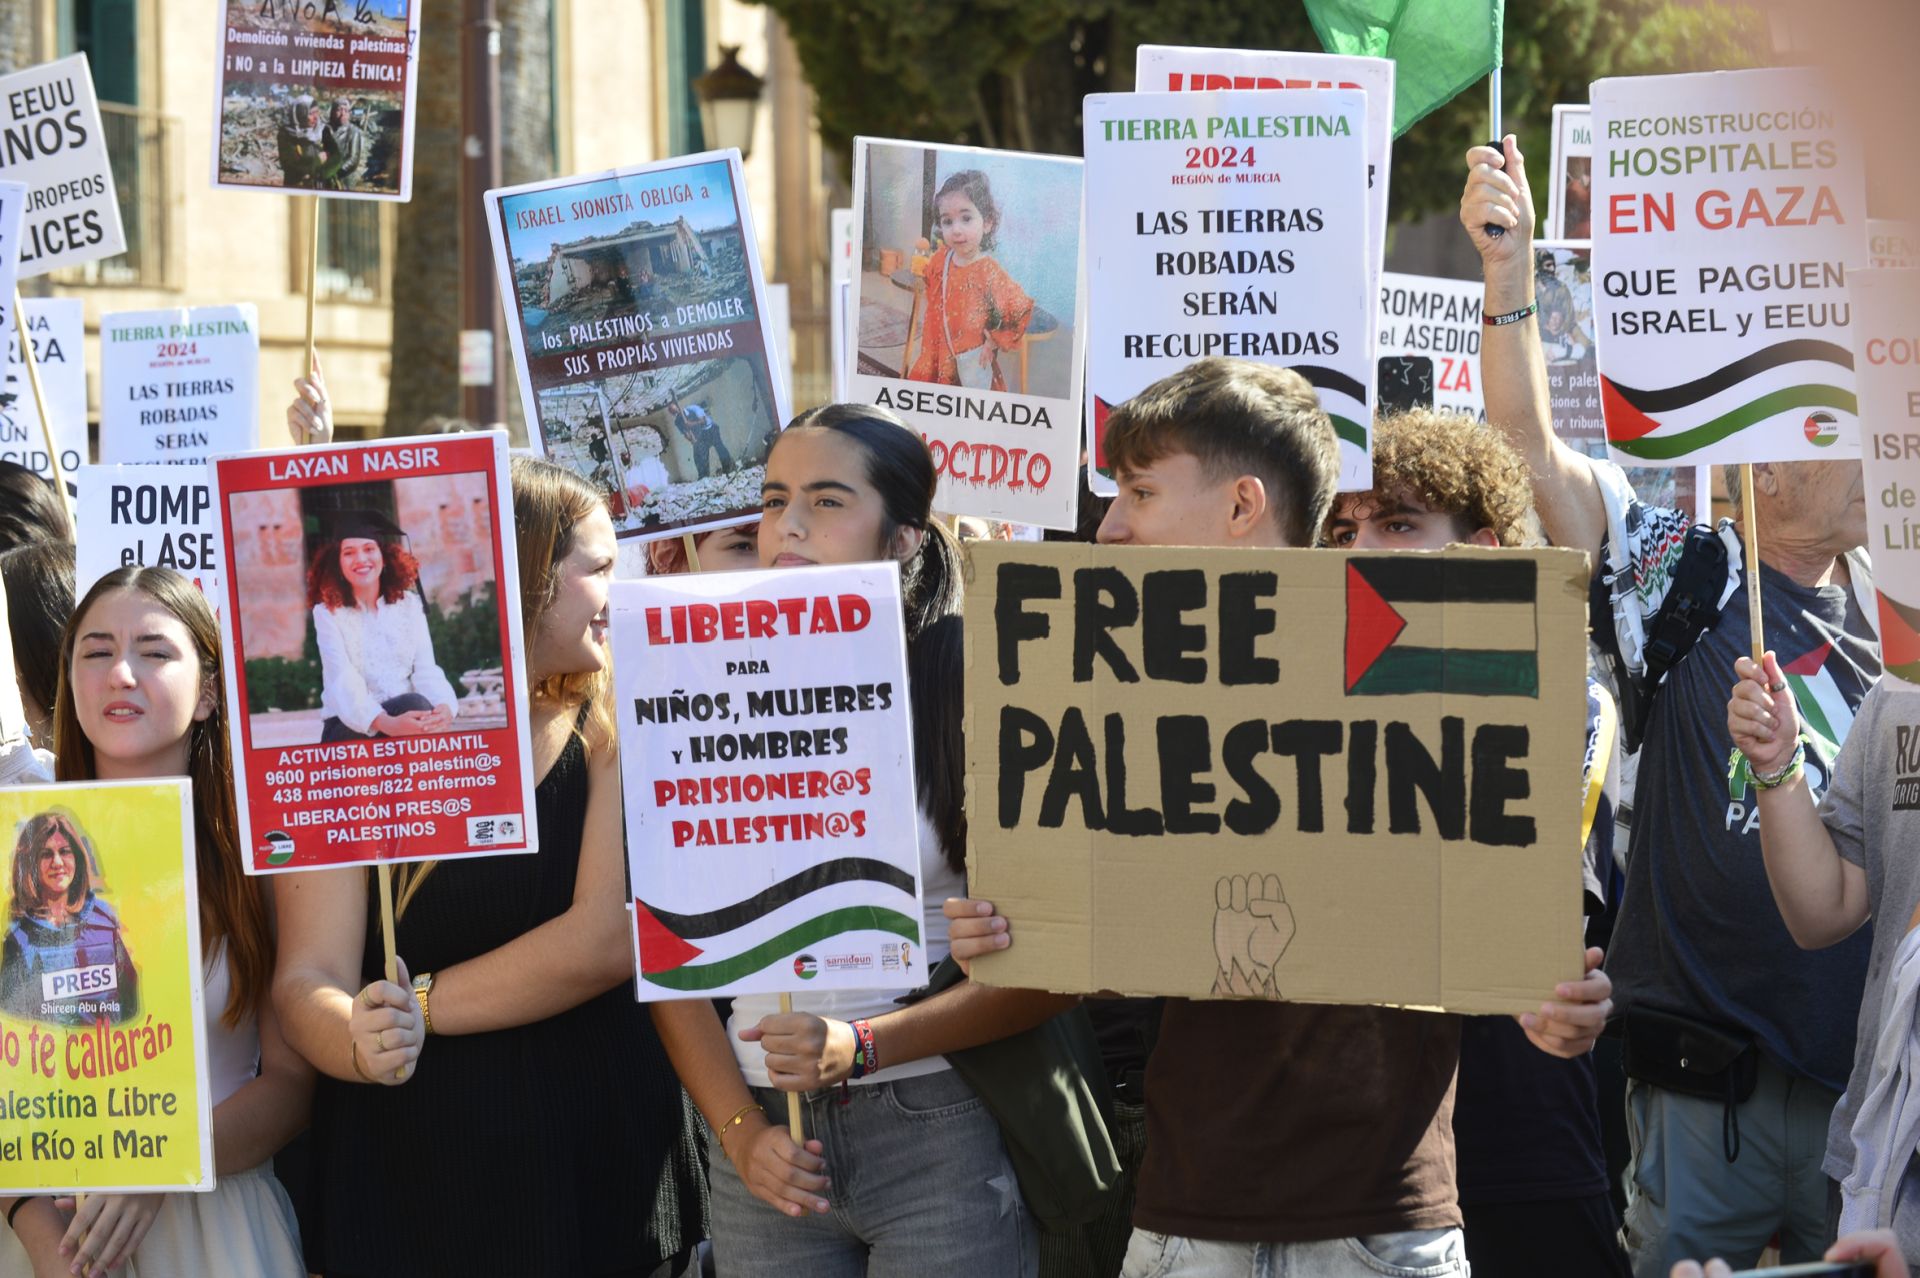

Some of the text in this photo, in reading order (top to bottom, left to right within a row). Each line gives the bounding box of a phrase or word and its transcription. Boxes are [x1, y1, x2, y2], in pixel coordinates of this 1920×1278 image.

[228, 28, 406, 54] Demolición viviendas palestinas
[259, 61, 267, 73] a
[273, 58, 285, 74] la
[291, 59, 346, 78] LIMPIEZA
[8, 77, 75, 121] EEUU
[1099, 114, 1351, 142] TIERRA PALESTINA
[1608, 107, 1835, 139] RECONSTRUCCIÓN
[1185, 146, 1257, 169] 2024
[1609, 140, 1838, 178] HOSPITALES
[1171, 171, 1281, 185] REGIÓN de MURCIA
[516, 184, 710, 230] ISRAEL SIONISTA OBLIGA a
[1136, 208, 1324, 235] LAS TIERRAS
[1609, 185, 1846, 234] EN GAZA
[1156, 250, 1295, 276] ROBADAS
[1603, 261, 1844, 299] QUE PAGUEN
[1183, 285, 1277, 317] SERÁN
[1381, 288, 1481, 325] ROMPAM
[111, 320, 249, 343] TIERRA PALESTINA
[541, 297, 745, 349] los PALESTINOS a DEMOLER
[1612, 303, 1850, 337] ISRAEL y EEUU
[157, 342, 197, 358] 2024
[563, 329, 734, 377] SUS PROPIAS VIVIENDAS
[1124, 331, 1340, 358] RECUPERADAS
[1380, 324, 1480, 355] el ASEDIO
[129, 378, 234, 401] LAS TIERRAS
[1585, 393, 1598, 409] de
[140, 404, 218, 426] ROBADAS
[875, 387, 1052, 429] ASESINADA
[155, 427, 208, 451] SERÁN
[269, 447, 440, 481] LAYAN NASIR
[922, 432, 1052, 491] OCIDIO
[111, 485, 210, 525] ROMP
[1881, 481, 1916, 508] de
[121, 532, 216, 570] el ASE
[645, 594, 871, 646] LIBERTAD
[995, 562, 1280, 686] FREE
[726, 660, 770, 675] PARA
[634, 682, 892, 725] NIÑOS, MUJERES
[278, 734, 489, 766] ACTIVISTA ESTUDIANTIL
[689, 727, 848, 763] HOMBRES
[265, 753, 501, 786] 9600 prisioneros palestin@s
[998, 705, 1537, 848] PALESTINE
[273, 774, 497, 804] 438 menores/822 enfermos
[653, 767, 871, 808] PRISIONER@S
[283, 797, 472, 828] LIBERACIÓN PRES@S
[327, 821, 436, 844] PALESTINOS
[671, 810, 866, 848] PALESTIN@S
[52, 968, 111, 995] PRESS
[41, 1001, 120, 1014] Shireen Abu Aqla
[29, 1024, 56, 1079] te
[66, 1014, 172, 1080] callarán
[108, 1087, 177, 1117] Libre
[0, 1129, 168, 1161] el Río al Mar
